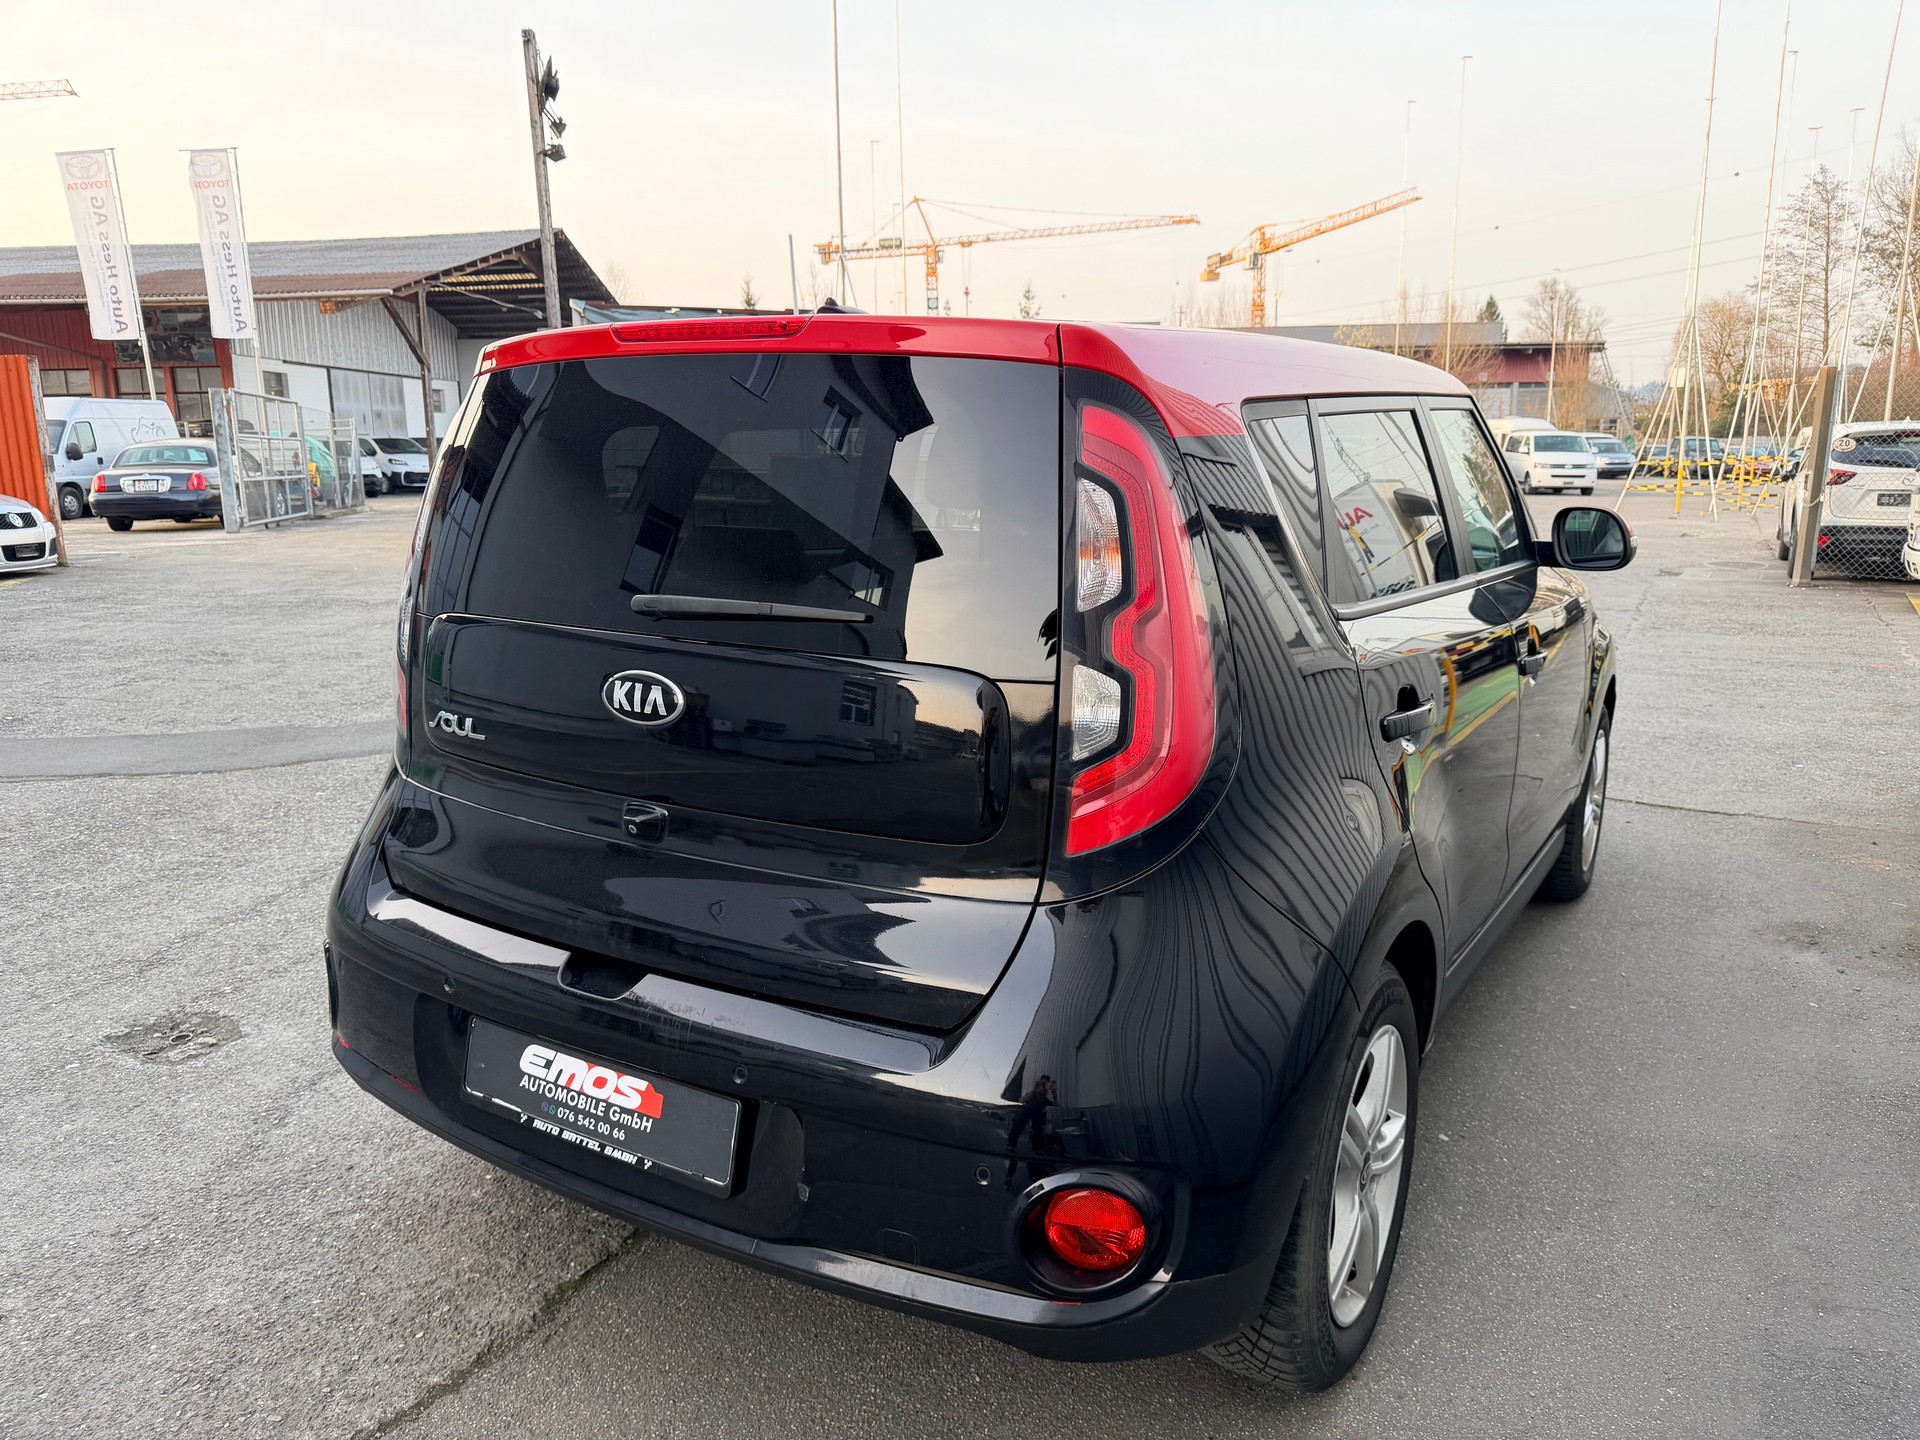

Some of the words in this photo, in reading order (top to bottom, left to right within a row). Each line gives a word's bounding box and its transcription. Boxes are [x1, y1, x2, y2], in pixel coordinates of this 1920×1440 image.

[613, 680, 668, 716] KIA
[428, 710, 487, 741] SOUL
[519, 1074, 606, 1116] AUTOMOBILE
[609, 1106, 653, 1133] GmbH
[532, 1119, 560, 1136] AUTO
[557, 1107, 575, 1122] 076
[577, 1115, 596, 1130] 542
[597, 1122, 611, 1135] 00
[612, 1128, 626, 1141] 66
